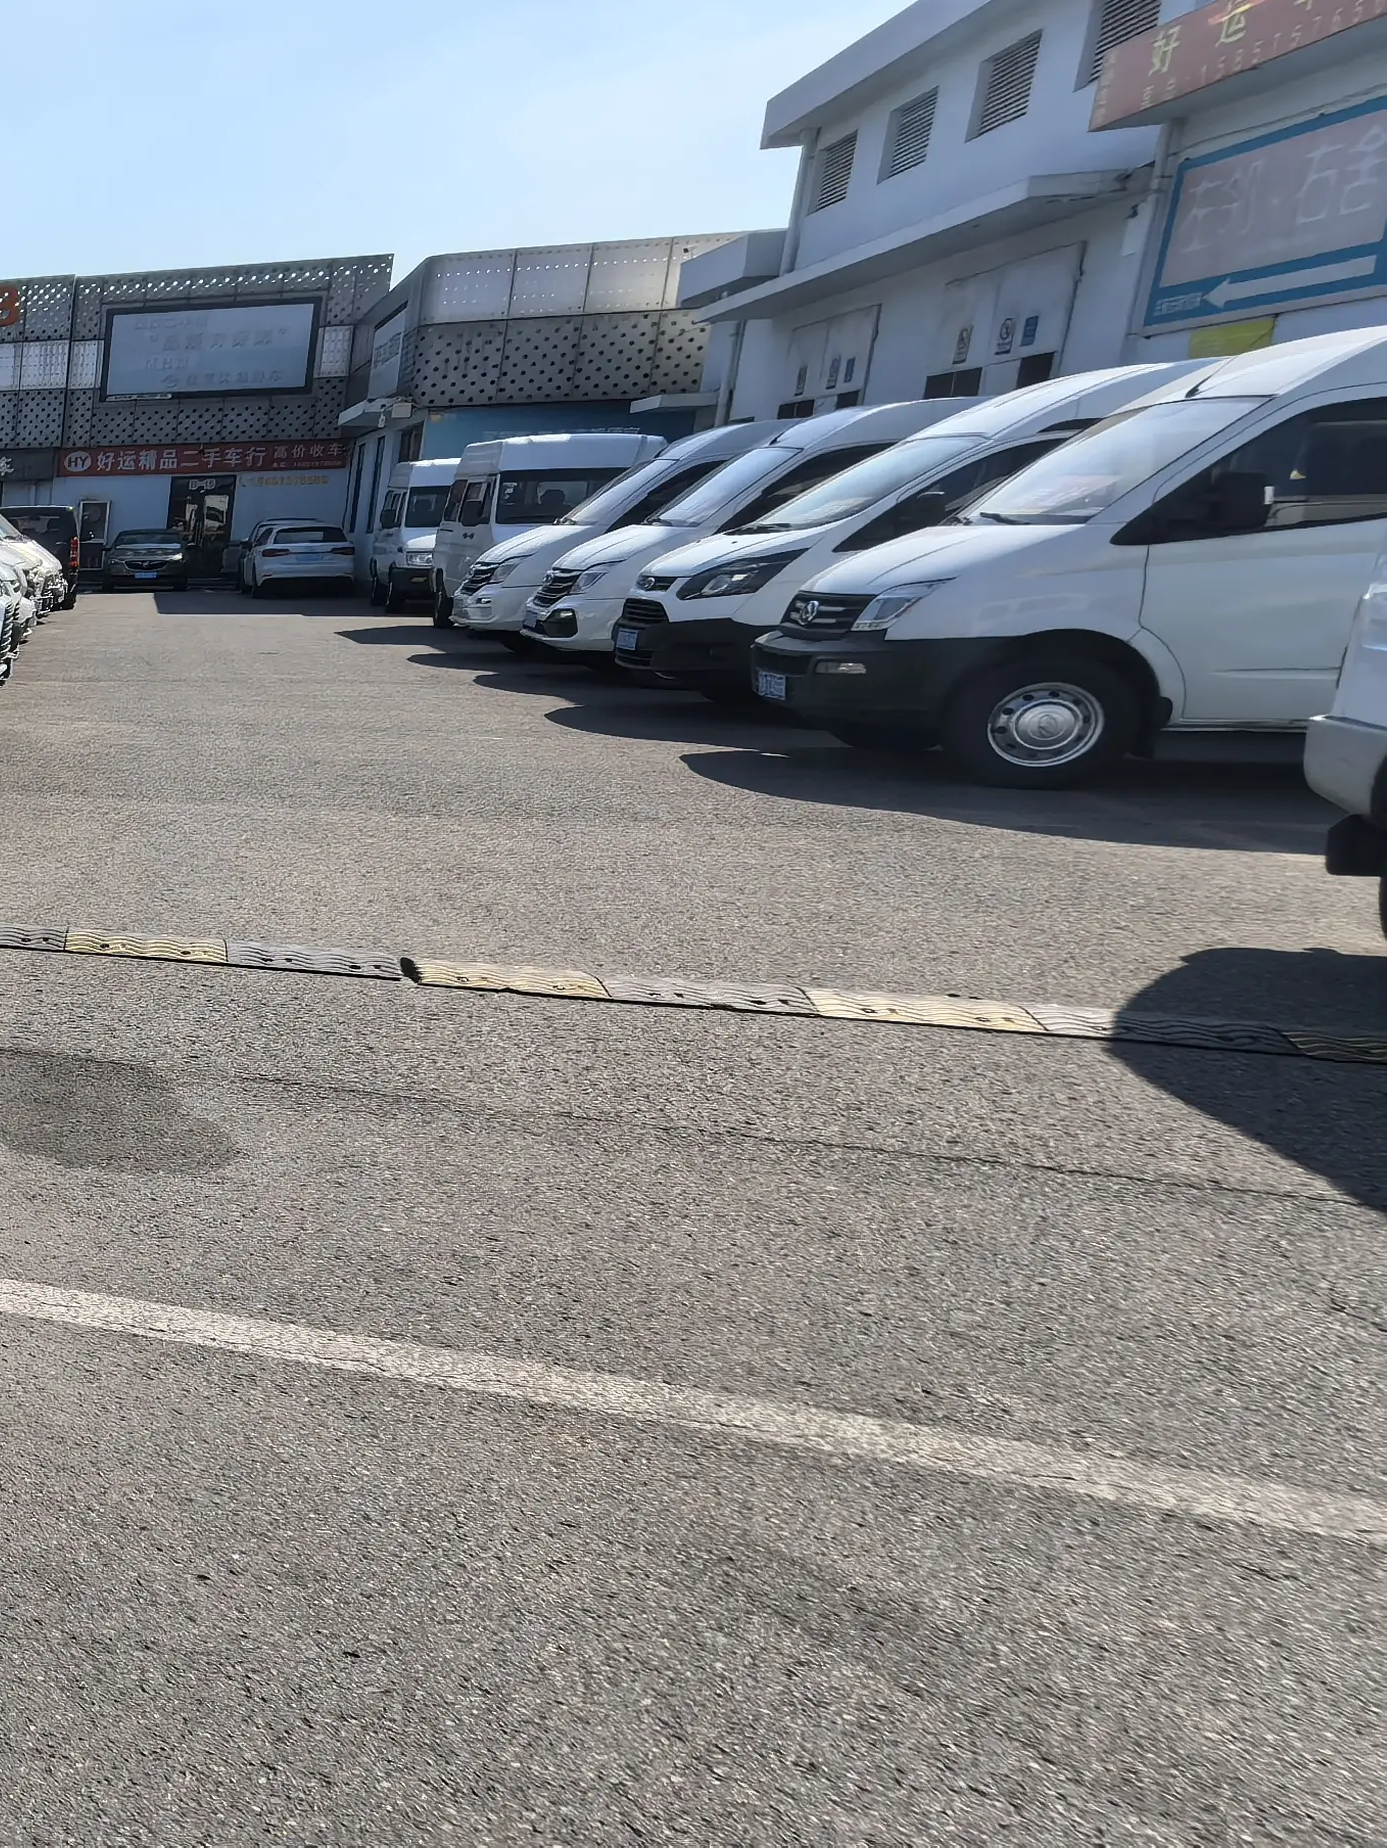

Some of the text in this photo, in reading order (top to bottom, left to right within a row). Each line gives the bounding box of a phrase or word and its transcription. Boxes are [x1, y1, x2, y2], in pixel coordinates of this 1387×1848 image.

[96, 447, 267, 472] 好运精品二手车行
